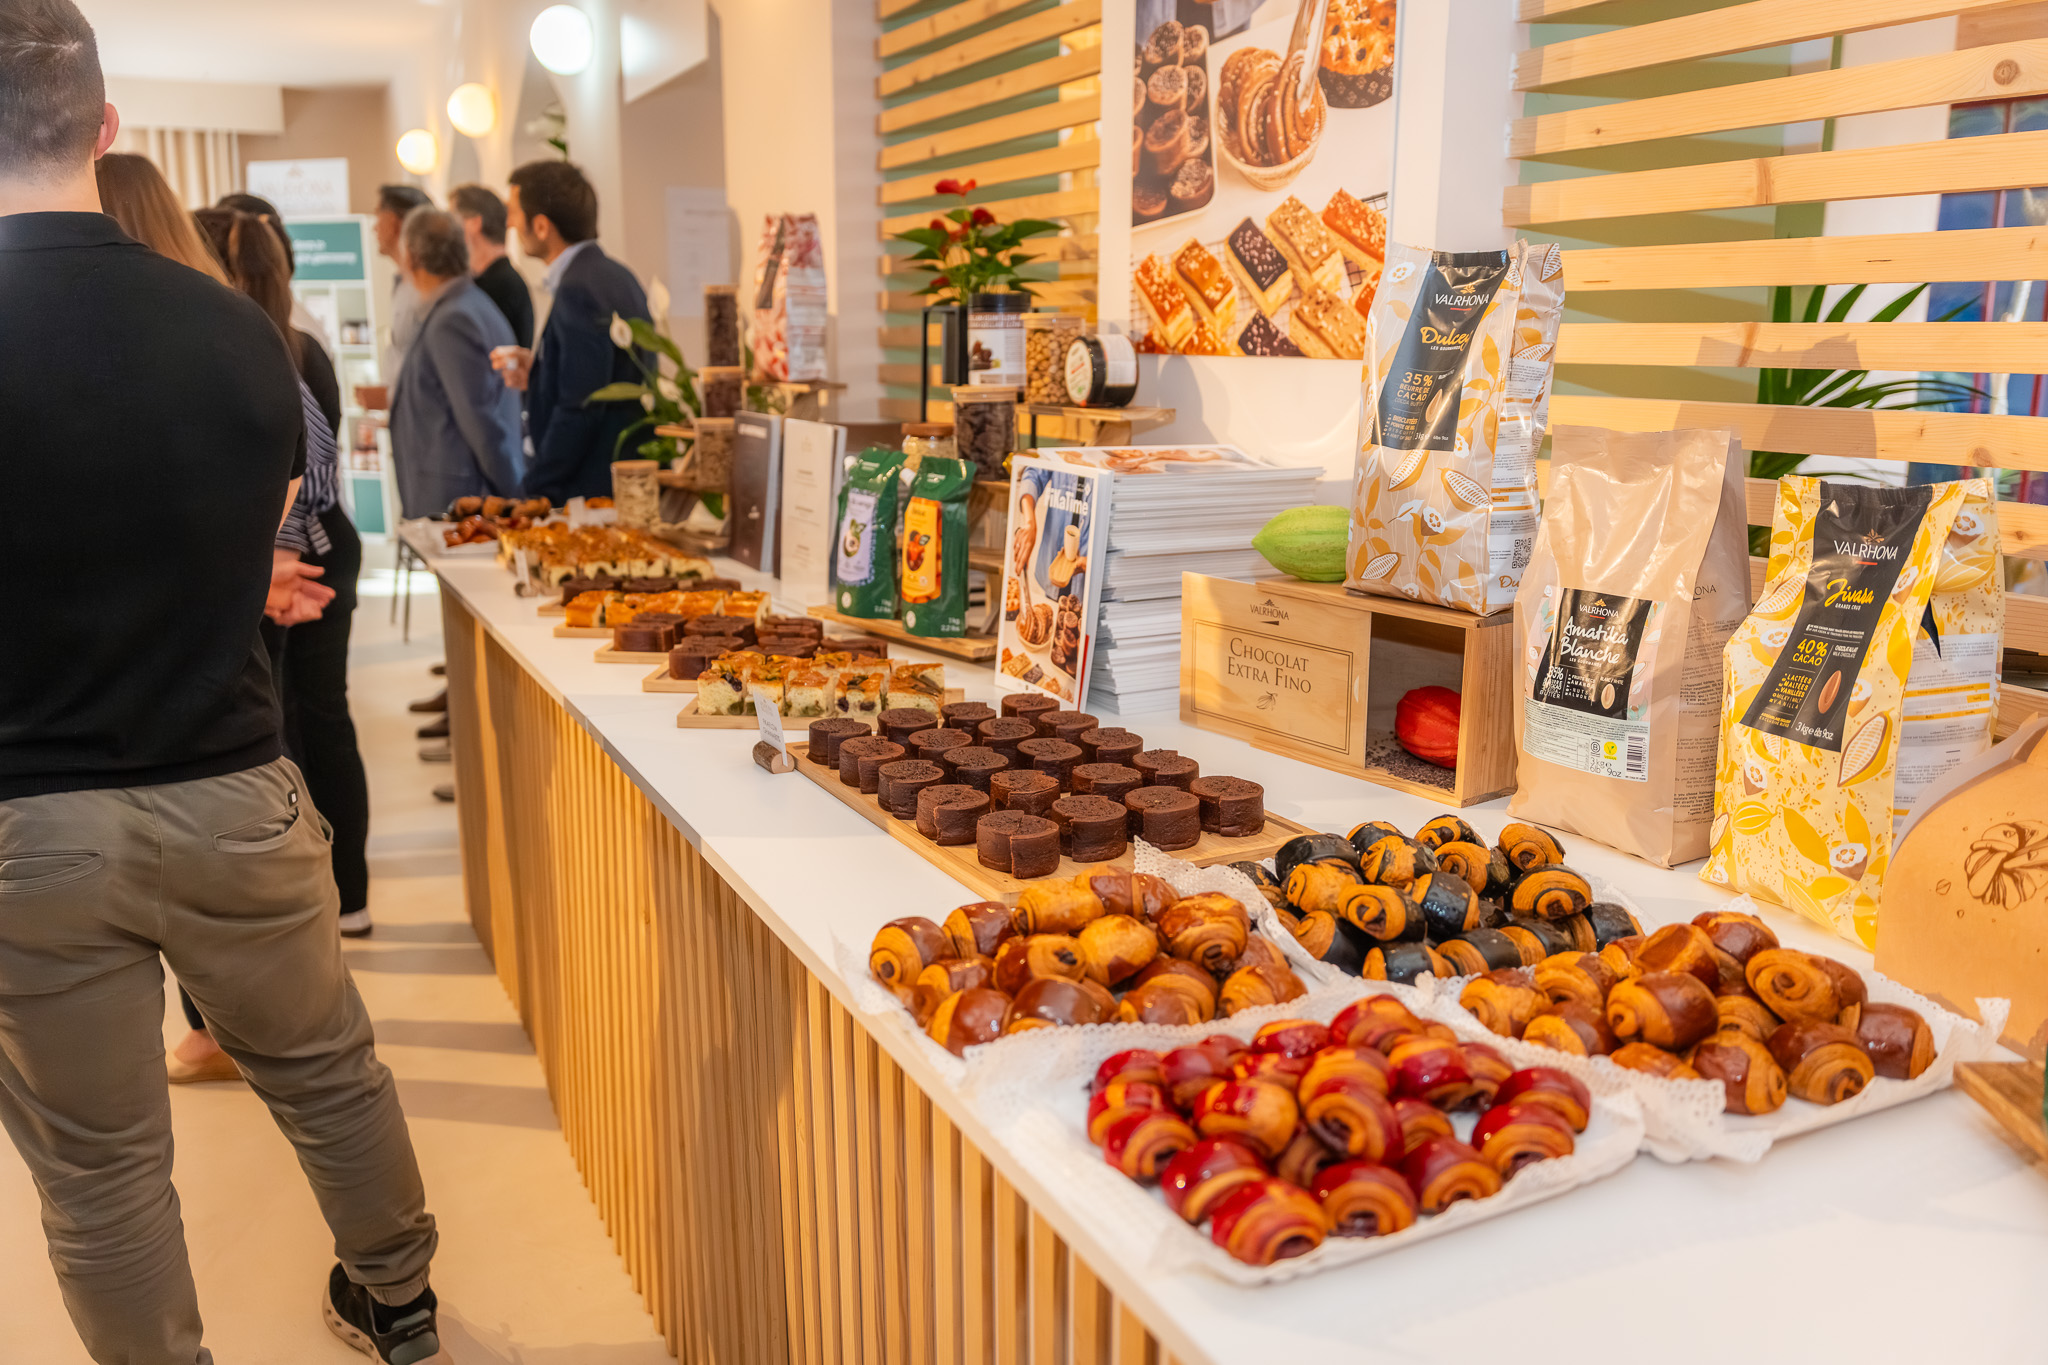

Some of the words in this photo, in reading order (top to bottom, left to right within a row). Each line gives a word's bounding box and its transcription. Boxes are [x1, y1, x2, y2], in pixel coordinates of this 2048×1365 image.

[1435, 293, 1490, 307] VALRHONA
[1420, 326, 1474, 352] Dulcey
[1402, 371, 1433, 387] 35%
[1396, 389, 1428, 402] CACAO
[1400, 383, 1423, 394] BEURRE
[1834, 540, 1899, 560] VALRHONA
[1499, 573, 1524, 588] Du
[1693, 585, 1717, 596] ONA
[1824, 578, 1875, 608] Jivara
[1250, 604, 1290, 621] VALRHONA
[1580, 604, 1620, 618] VALRHONA
[1563, 616, 1629, 645] Amatika
[1230, 637, 1309, 672] CHOCOLAT
[1560, 636, 1621, 664] Blanche
[1797, 638, 1829, 657] 40%
[1792, 652, 1823, 666] CACAO
[1228, 656, 1270, 684] EXTRA
[1275, 668, 1312, 693] FINO
[1787, 673, 1812, 684] LACTÉES
[1784, 680, 1809, 691] MALTÉES
[1606, 767, 1622, 778] 9oz
